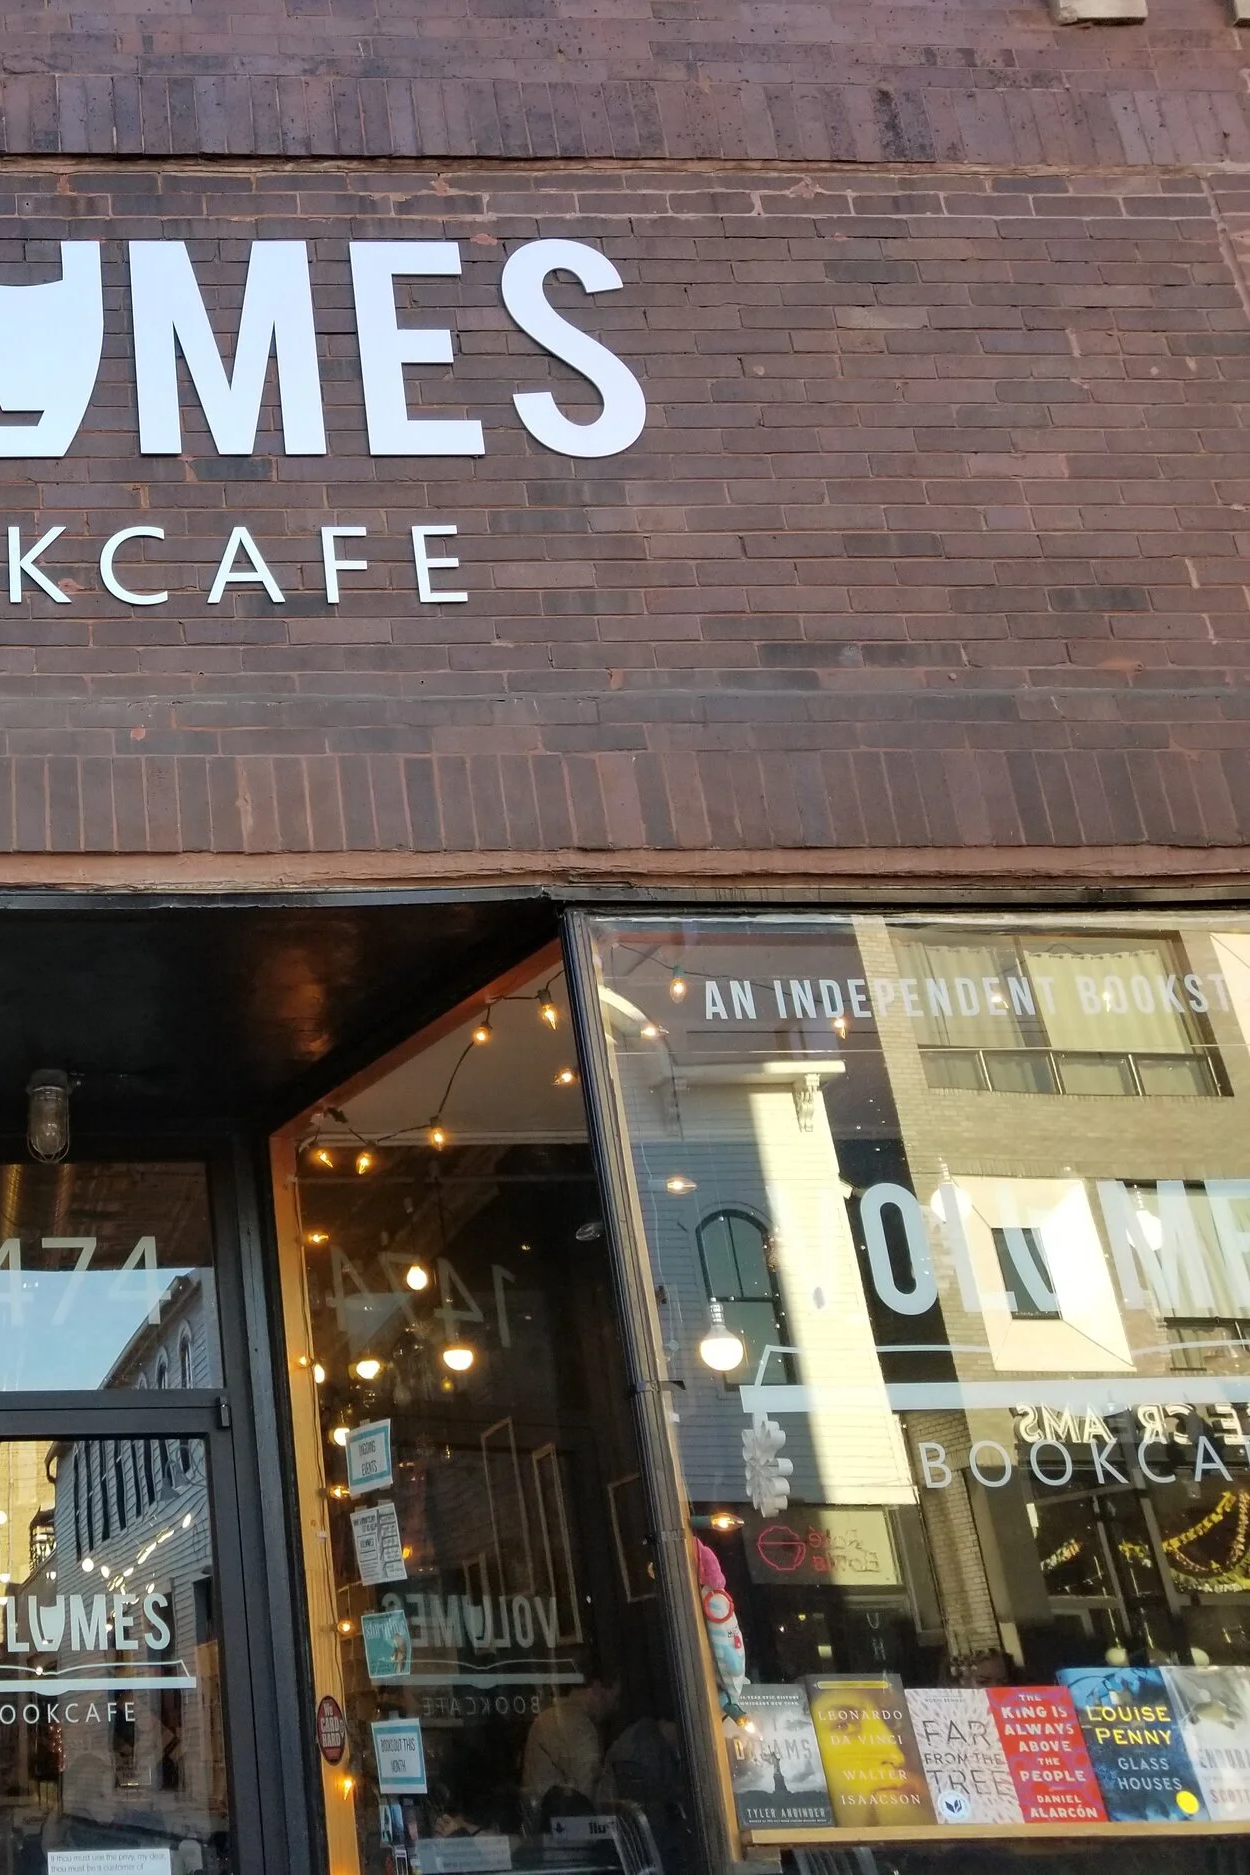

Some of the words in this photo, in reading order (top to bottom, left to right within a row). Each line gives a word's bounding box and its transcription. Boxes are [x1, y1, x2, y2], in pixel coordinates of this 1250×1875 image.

[705, 980, 756, 1021] AN
[776, 976, 1054, 1020] INDEPENDENT
[918, 1435, 1250, 1488] BOOKCA
[361, 1461, 377, 1476] EVENTS
[818, 1710, 902, 1721] LEONARDO
[1051, 1705, 1068, 1718] IS
[320, 1717, 339, 1733] CARD
[1005, 1723, 1075, 1736] ALWAYS
[922, 1720, 991, 1746] FAR
[1095, 1727, 1171, 1745] PENNY
[322, 1733, 341, 1747] HARD
[403, 1738, 416, 1751] THIS
[831, 1735, 851, 1745] DA
[858, 1735, 903, 1745] VINCI
[1019, 1741, 1072, 1752] ABOVE
[924, 1753, 968, 1765] FROM
[972, 1753, 1007, 1765] THE
[1038, 1758, 1060, 1766] THE
[1117, 1757, 1170, 1770] GLASS
[843, 1770, 908, 1780] WALTER
[1019, 1770, 1087, 1782] PEOPLE
[926, 1769, 1014, 1796] TREE
[1117, 1777, 1183, 1790] HOUSES
[841, 1794, 921, 1805] ISAACSON
[1036, 1794, 1082, 1804] DANIEL
[747, 1808, 776, 1818] TYLER
[1030, 1804, 1098, 1818] ALARCÓN
